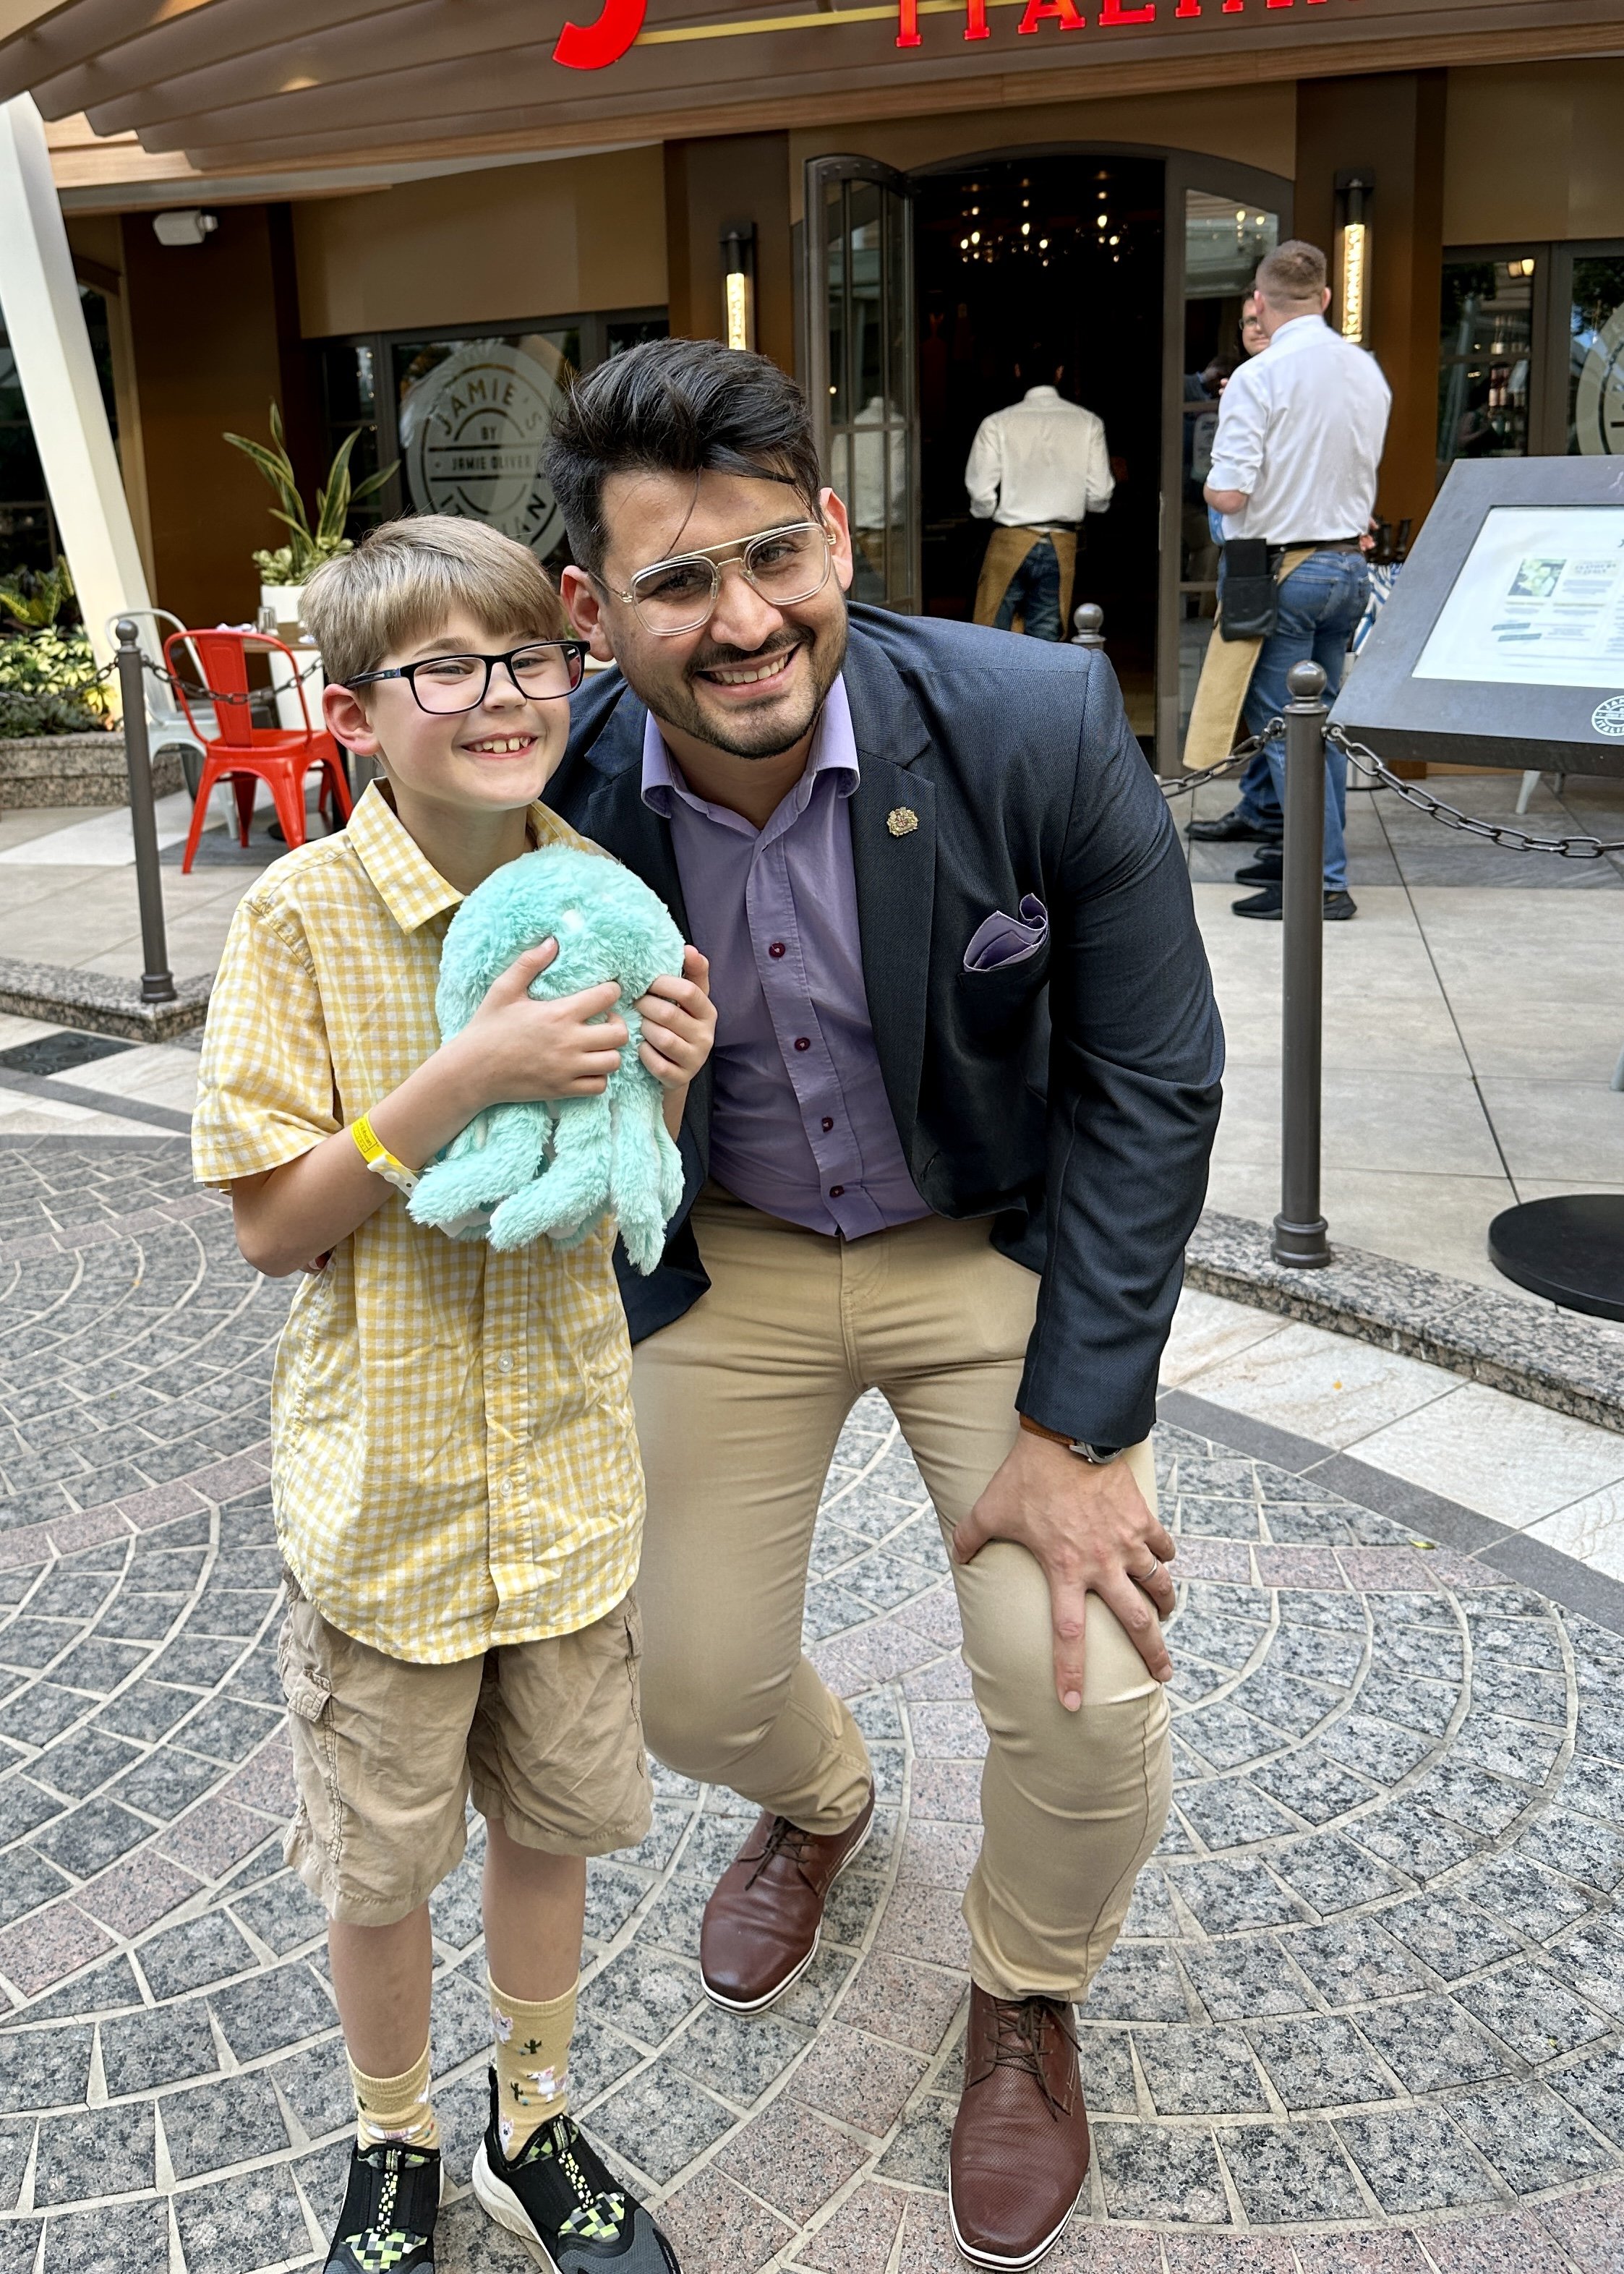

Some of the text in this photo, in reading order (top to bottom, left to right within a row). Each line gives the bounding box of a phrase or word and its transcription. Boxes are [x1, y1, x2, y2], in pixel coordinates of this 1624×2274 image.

[436, 377, 543, 437] JAMIE'S
[481, 425, 497, 440] BY
[451, 454, 531, 471] JAMIE OLIVER
